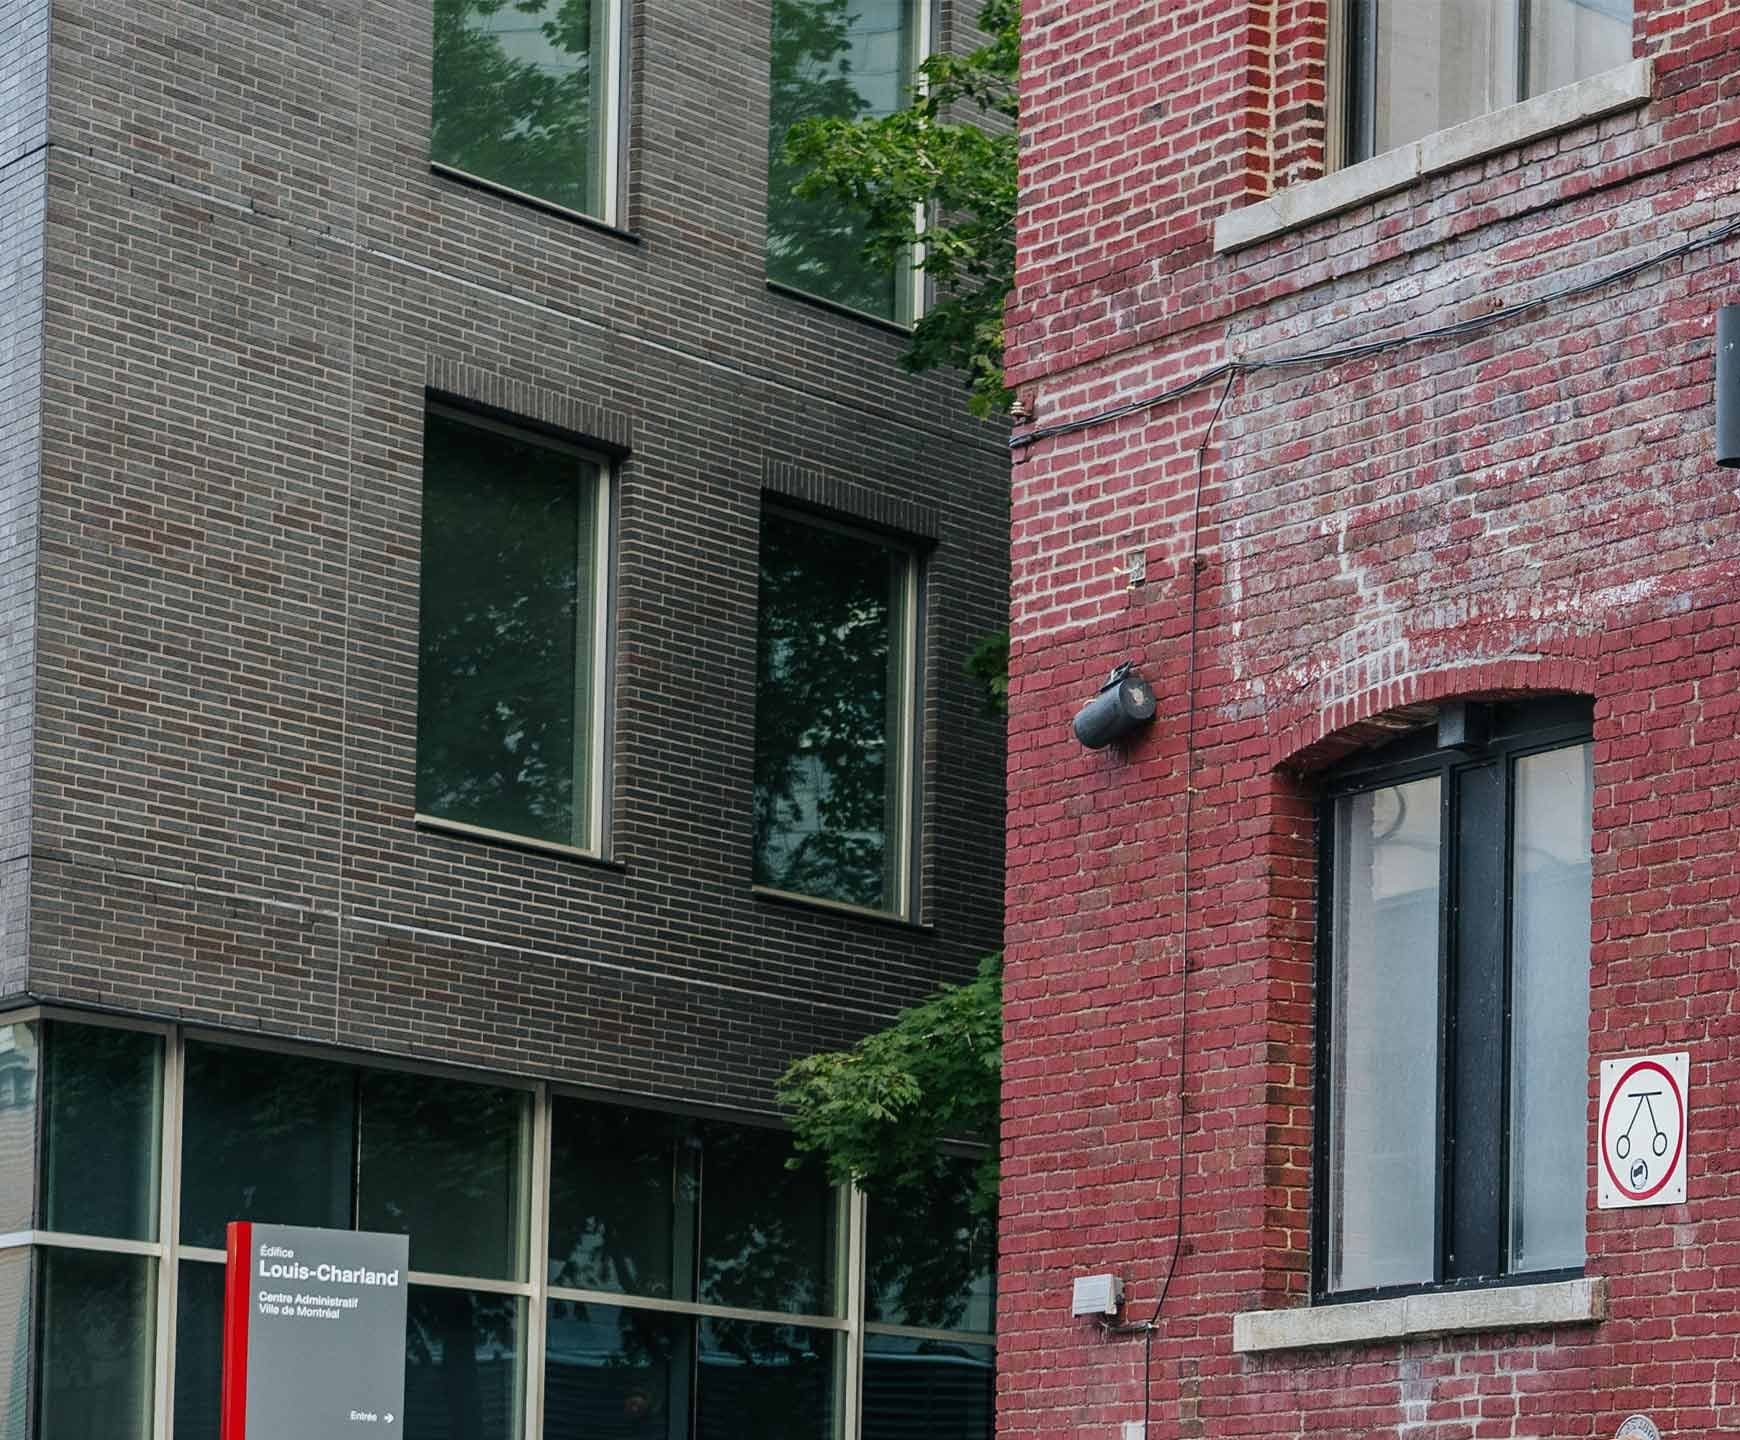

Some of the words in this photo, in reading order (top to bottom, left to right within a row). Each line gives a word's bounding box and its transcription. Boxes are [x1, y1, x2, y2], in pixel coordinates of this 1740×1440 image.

[260, 1243, 294, 1259] Édifice
[259, 1260, 399, 1286] Louis-Charland
[259, 1291, 293, 1304] Centre
[294, 1293, 358, 1308] Administratif
[259, 1303, 280, 1314] Ville
[281, 1305, 294, 1316] de
[297, 1306, 340, 1319] Montréal
[350, 1410, 377, 1422] Entrée
